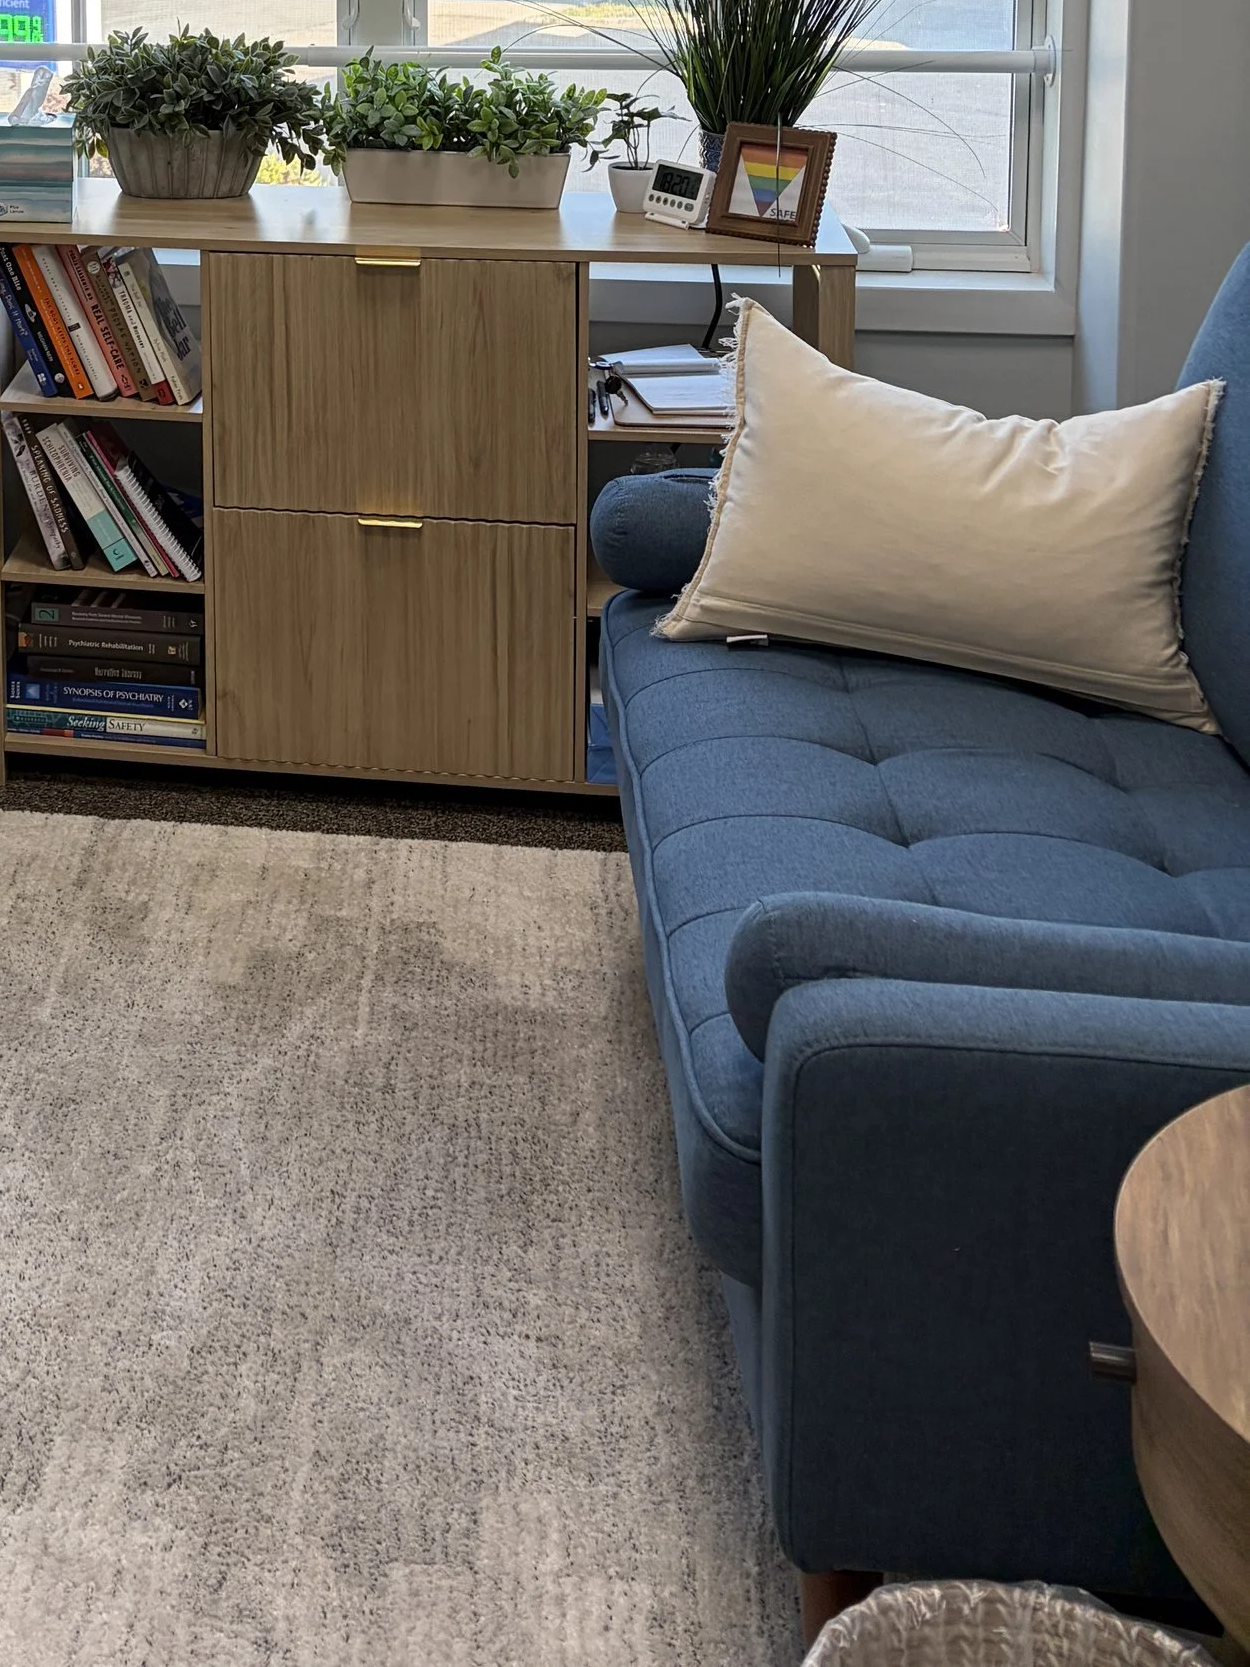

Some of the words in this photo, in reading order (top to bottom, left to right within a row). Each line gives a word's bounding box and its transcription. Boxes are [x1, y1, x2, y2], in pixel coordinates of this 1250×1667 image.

[770, 208, 796, 220] SAFE
[5, 261, 15, 276] One
[11, 275, 22, 291] Bite
[118, 290, 133, 314] TRAUMA
[89, 303, 105, 325] REAL
[98, 325, 126, 370] SELF-CARE
[30, 444, 51, 483] SPEAKING
[41, 435, 73, 482] SCHIZOPHRENIA
[57, 444, 80, 477] SURVIVING
[27, 469, 49, 512] BURDEN
[45, 484, 55, 495] OF
[49, 497, 70, 533] SADNESS
[38, 609, 55, 620] 2
[68, 639, 100, 648] Psychiatric
[101, 641, 144, 651] Rehabilitation
[63, 686, 102, 697] SYNOPSIS
[103, 689, 115, 698] OF
[116, 691, 164, 703] PSYCHIATRY
[67, 715, 106, 732] Seeking
